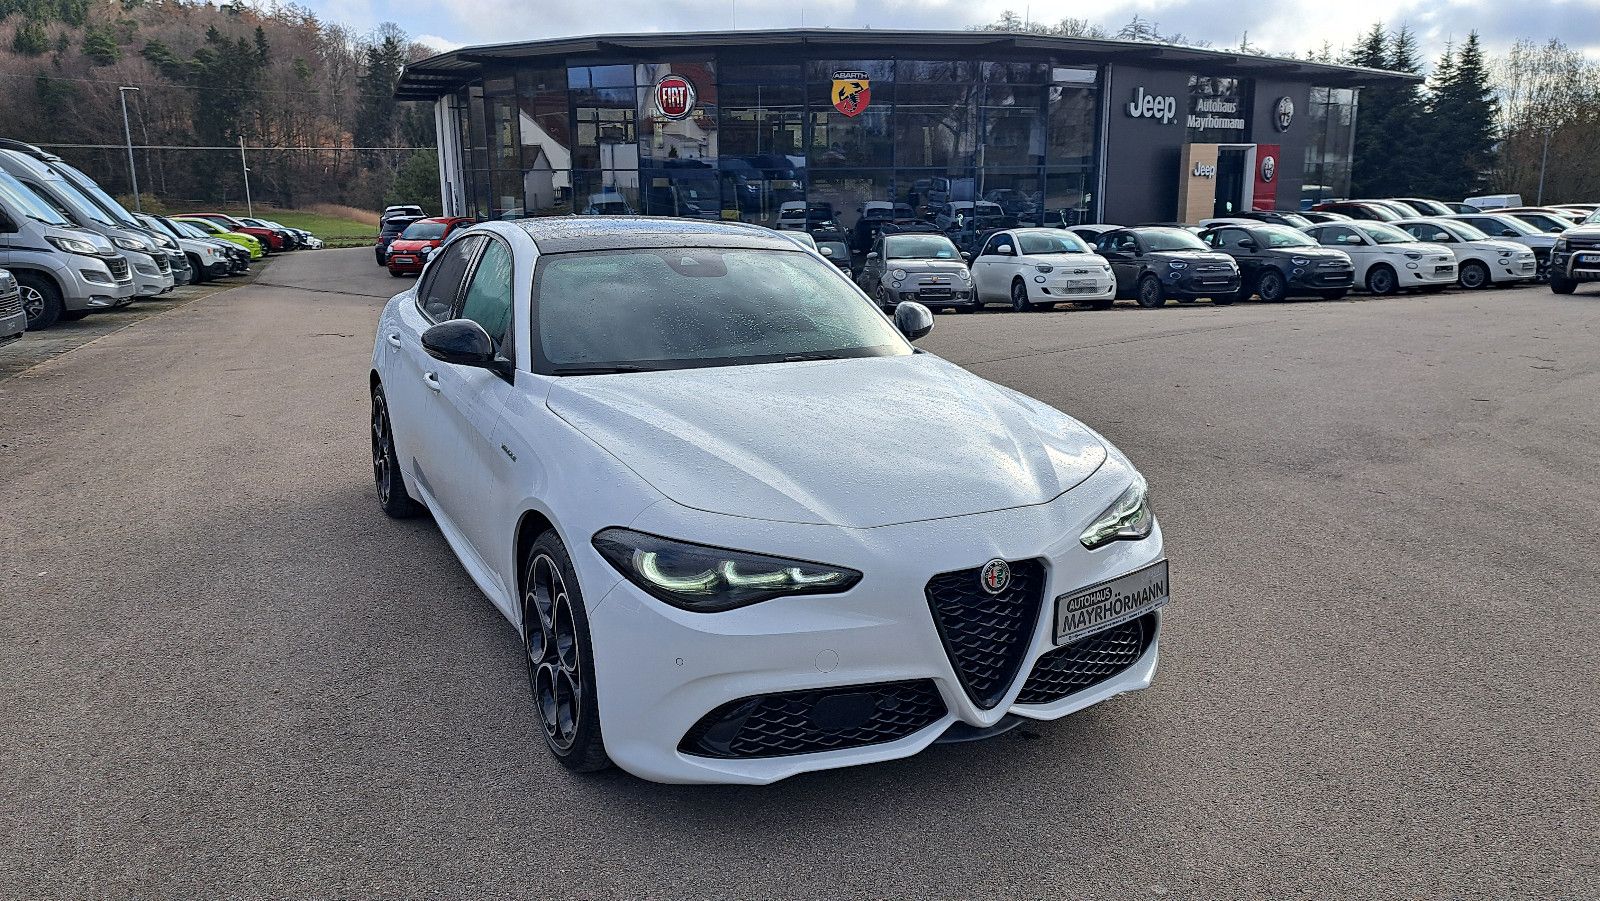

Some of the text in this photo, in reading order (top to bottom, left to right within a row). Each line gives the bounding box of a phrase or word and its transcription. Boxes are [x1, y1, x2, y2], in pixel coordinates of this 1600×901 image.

[662, 87, 685, 108] FIAT
[1130, 87, 1176, 124] Jeep
[1197, 98, 1236, 113] Autohaus
[1187, 113, 1245, 131] Mayrhörmann
[1193, 162, 1215, 179] Jeep
[1062, 581, 1164, 633] MAYRHÖRMANN
[1069, 588, 1112, 611] AUTOHAUS
